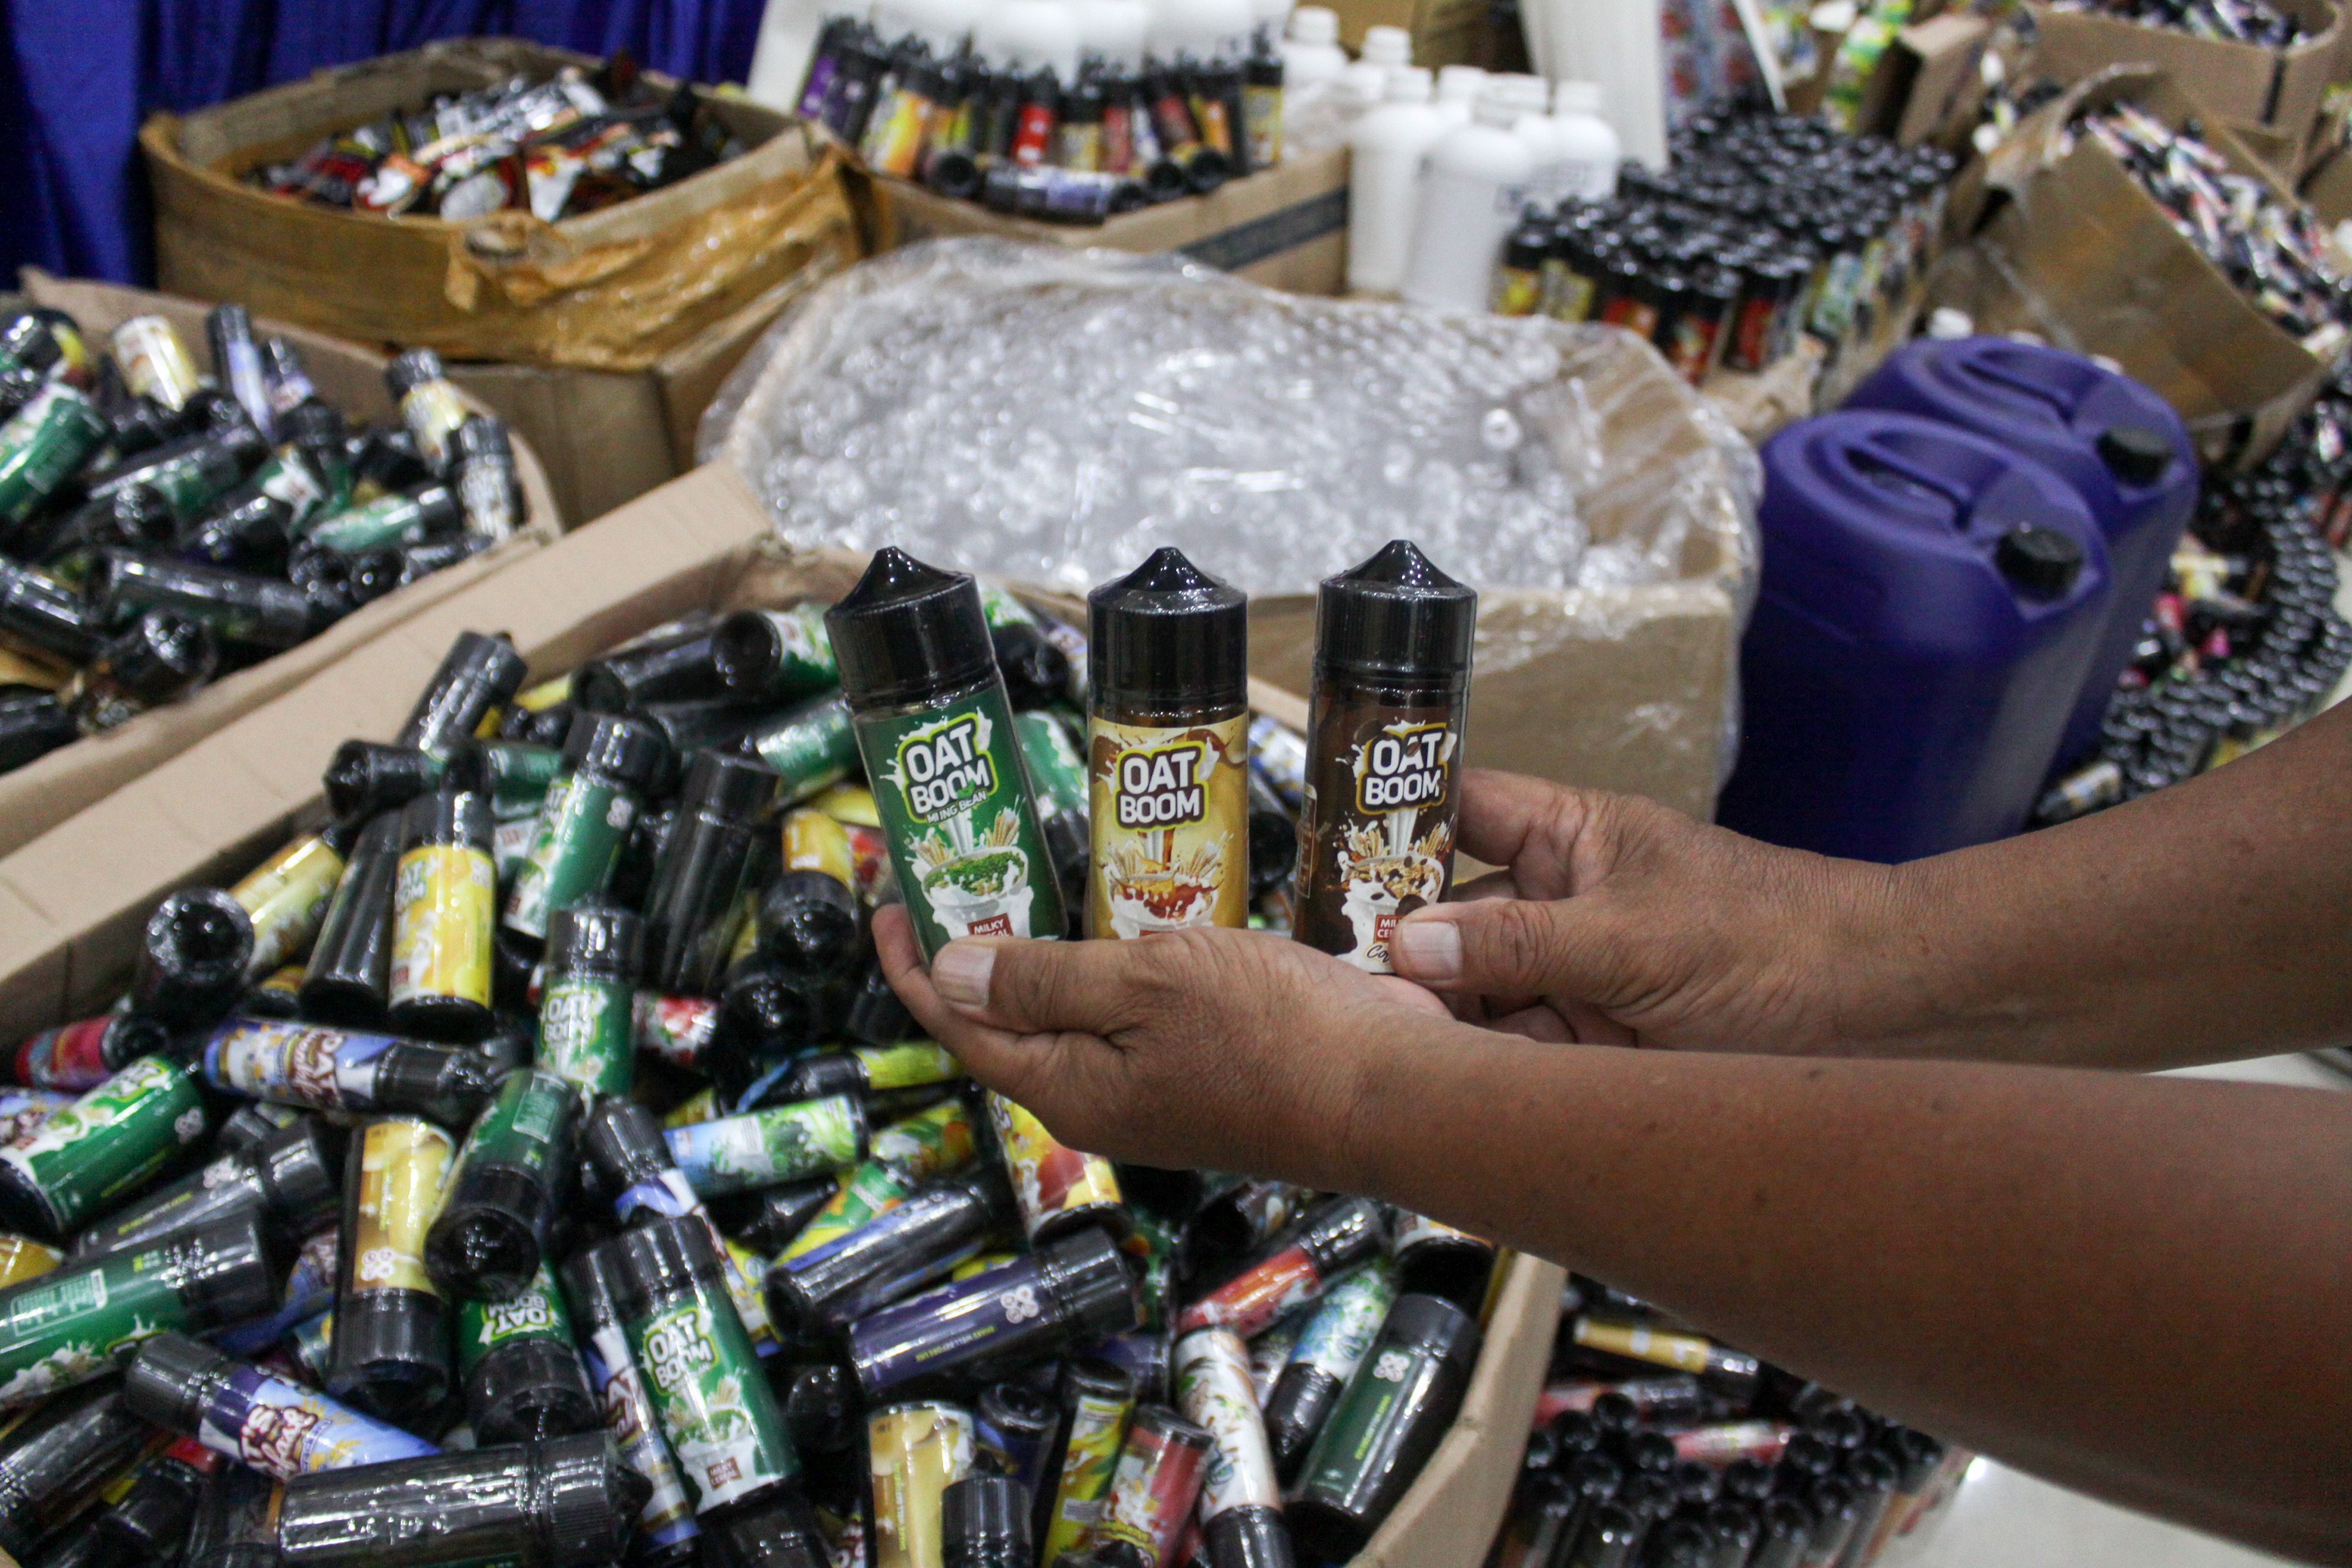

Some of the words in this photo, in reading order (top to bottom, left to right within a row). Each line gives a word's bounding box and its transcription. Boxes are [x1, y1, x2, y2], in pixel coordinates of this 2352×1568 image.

[906, 723, 973, 783] OAT
[1373, 732, 1442, 775] OAT
[910, 759, 990, 814] BOOM
[1124, 751, 1197, 794] OAT
[1365, 770, 1441, 805] BOOM
[927, 804, 958, 823] MUNG
[958, 790, 987, 811] BEAN
[1120, 788, 1200, 823] BOOM
[974, 918, 1004, 935] MILKY
[548, 993, 593, 1022] OAT
[495, 1306, 547, 1334] OAT
[649, 1313, 696, 1363] OAT
